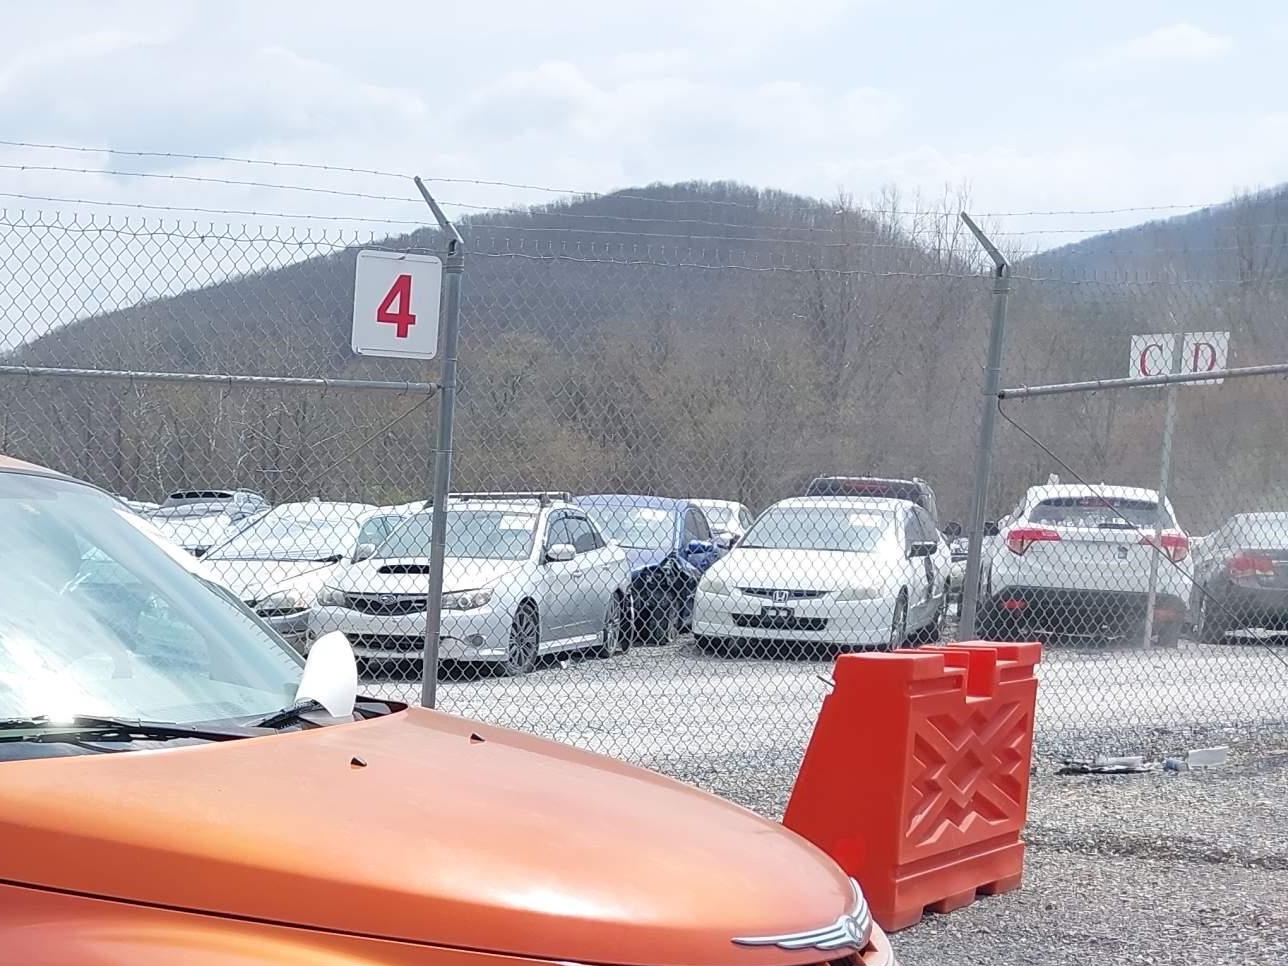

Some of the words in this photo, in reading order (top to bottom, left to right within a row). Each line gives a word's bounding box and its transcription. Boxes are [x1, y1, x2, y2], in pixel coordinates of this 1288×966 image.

[377, 275, 416, 338] 4
[1139, 344, 1163, 376] C
[1193, 342, 1216, 373] D
